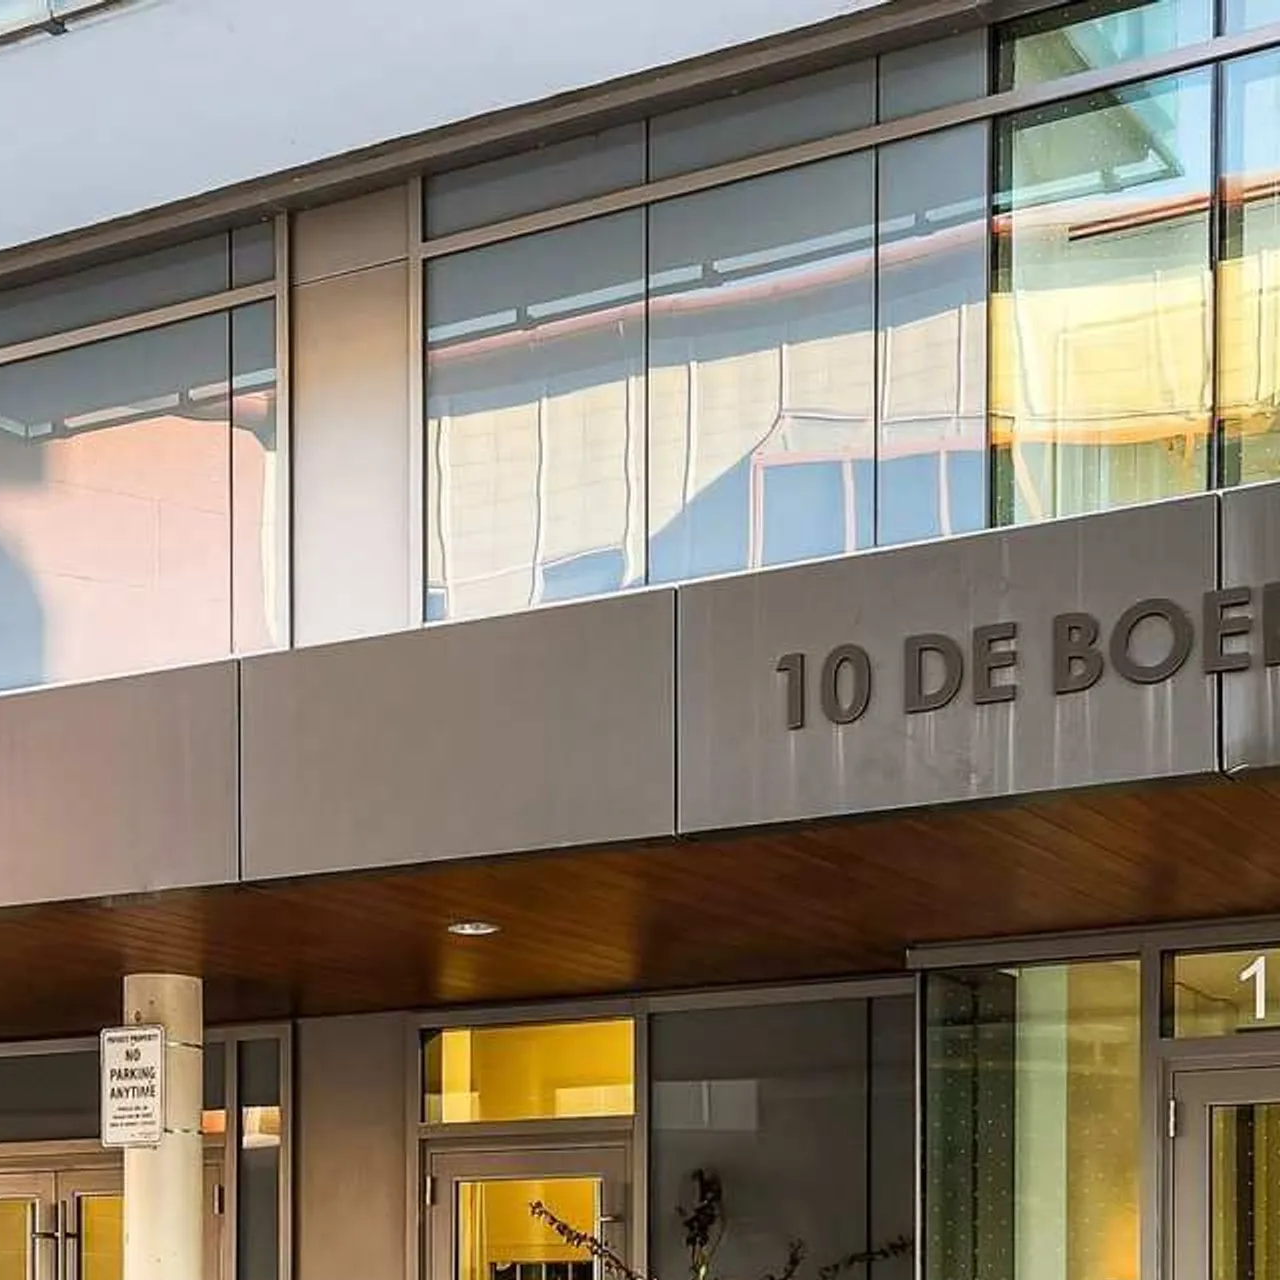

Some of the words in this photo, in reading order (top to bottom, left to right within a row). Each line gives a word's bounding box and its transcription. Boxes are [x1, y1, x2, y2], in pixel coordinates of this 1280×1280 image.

[776, 643, 871, 730] 10
[904, 621, 1018, 715] DE
[125, 1048, 141, 1062] NO
[109, 1066, 156, 1081] PARKING
[109, 1085, 156, 1099] ANYTIME
